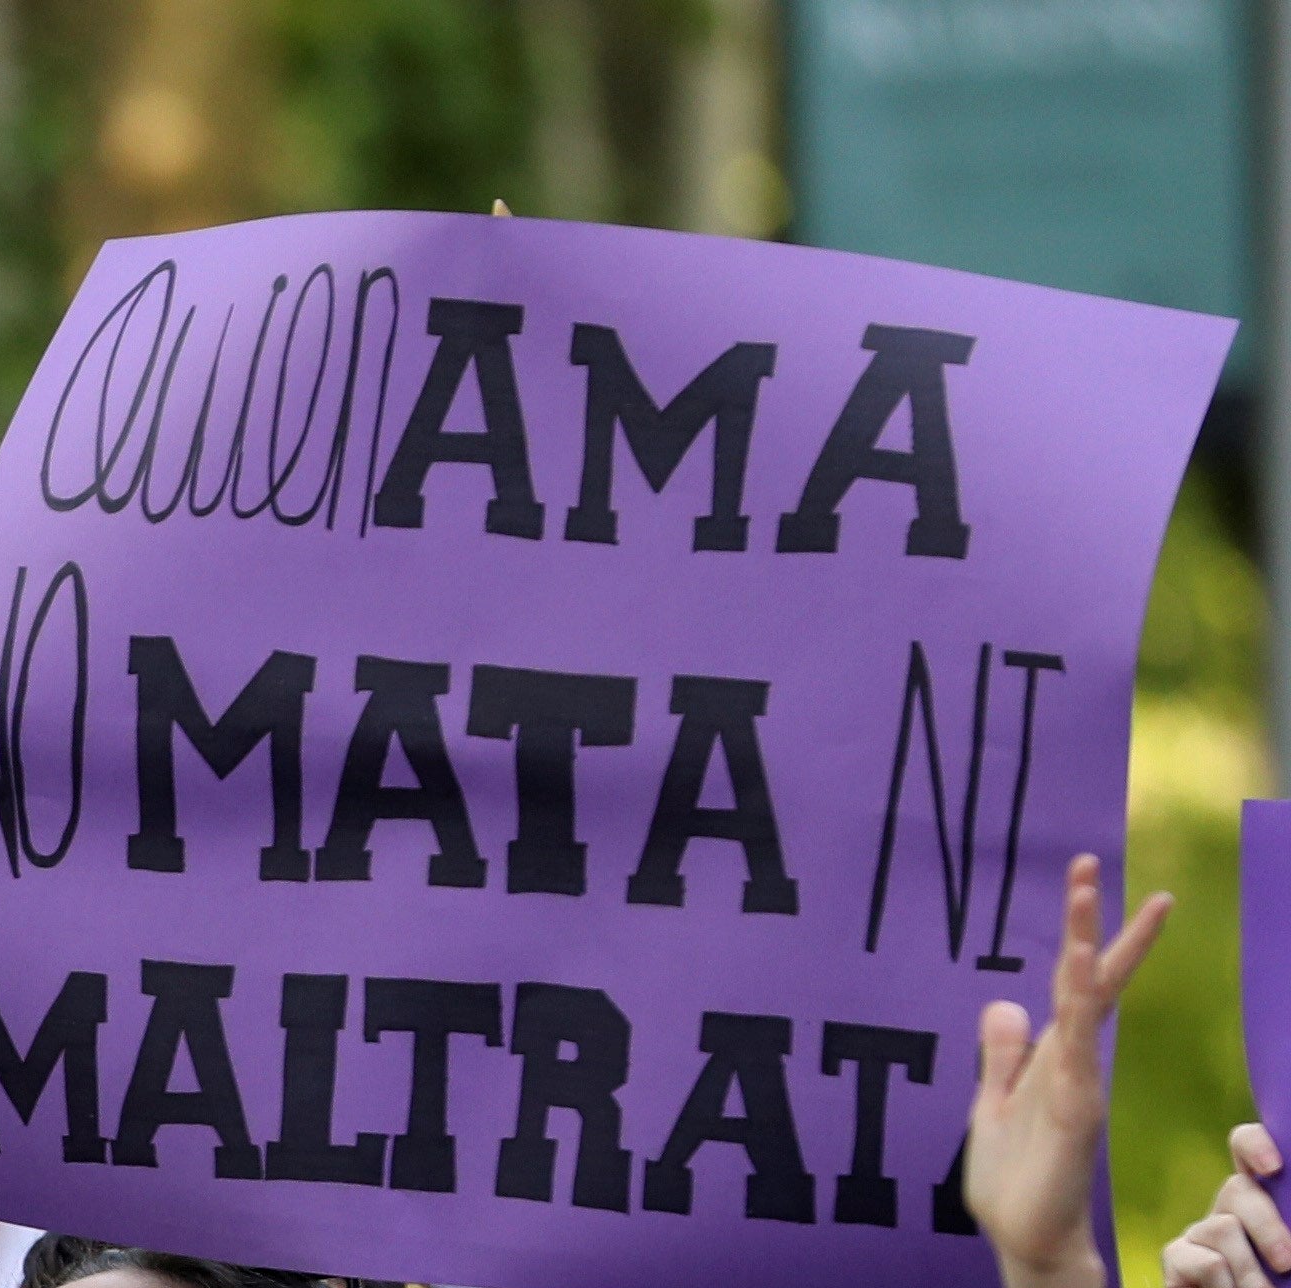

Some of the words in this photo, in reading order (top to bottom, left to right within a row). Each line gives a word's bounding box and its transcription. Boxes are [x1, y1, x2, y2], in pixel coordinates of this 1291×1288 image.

[373, 297, 977, 560] AMA
[125, 634, 802, 917] MATA
[863, 640, 1067, 974] NI
